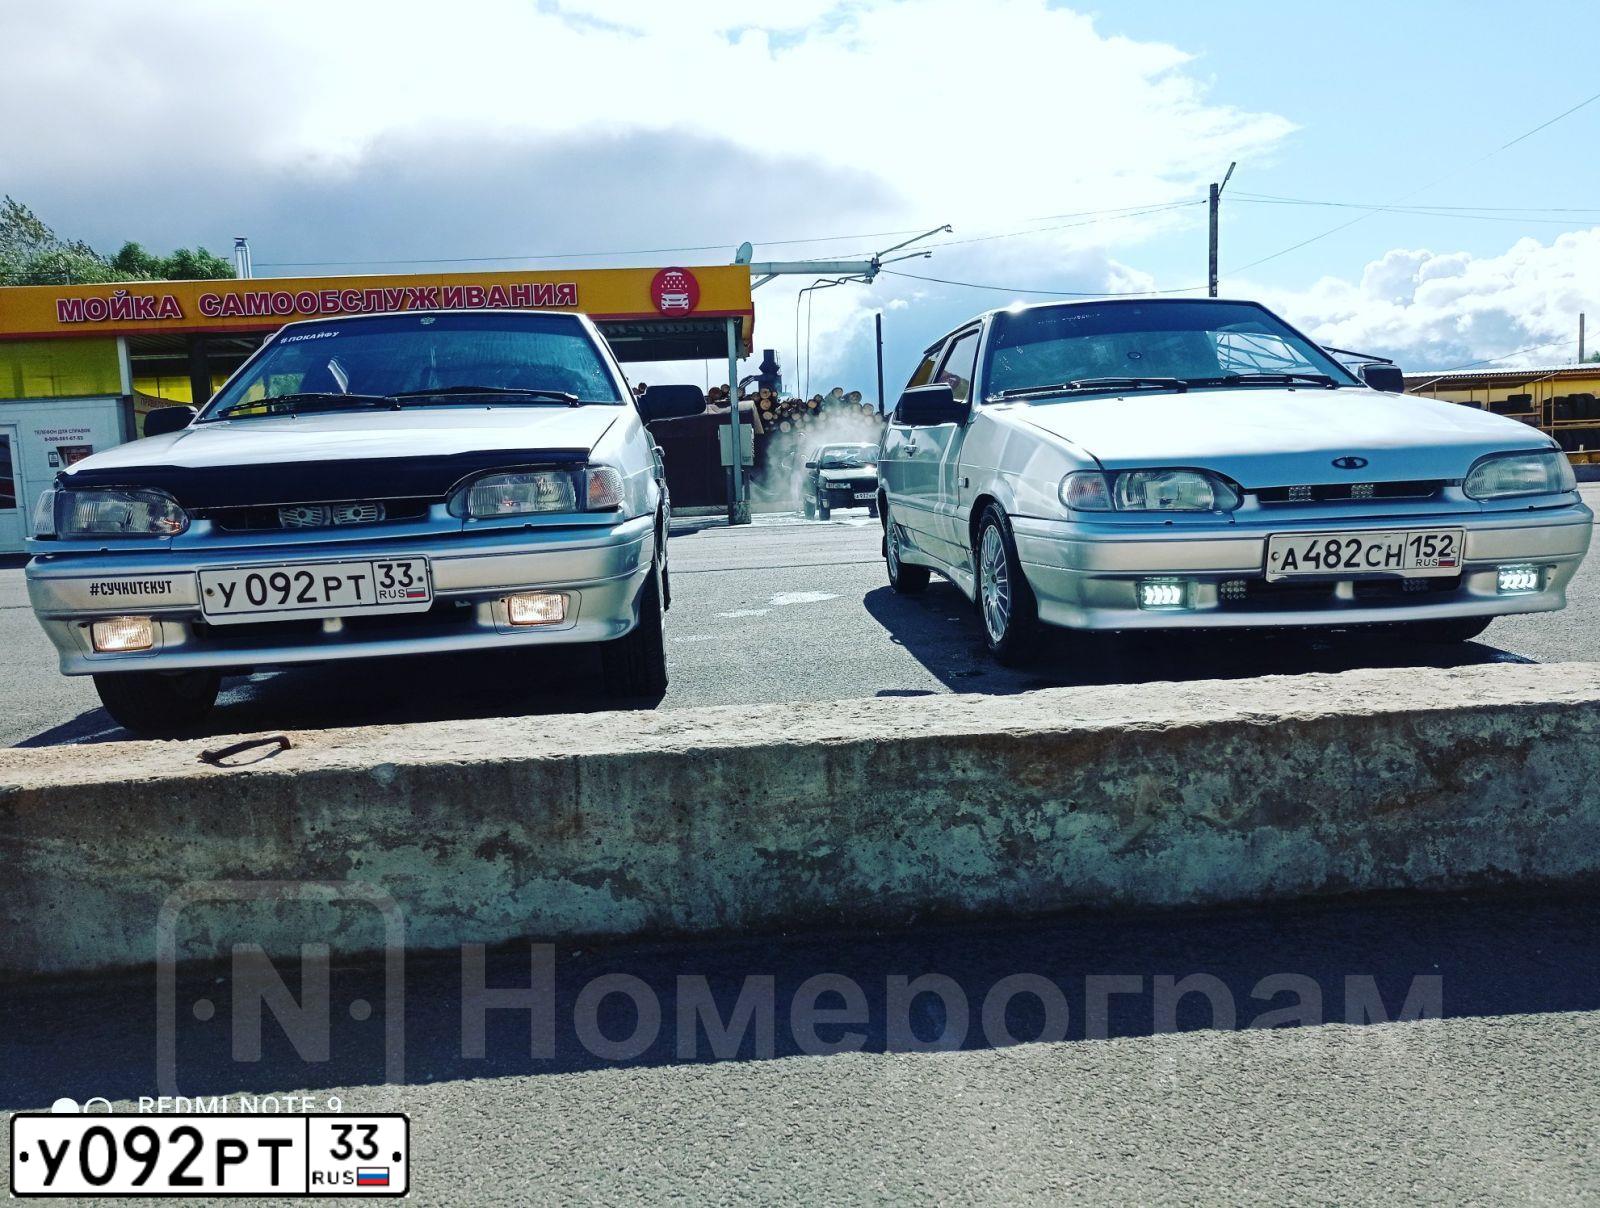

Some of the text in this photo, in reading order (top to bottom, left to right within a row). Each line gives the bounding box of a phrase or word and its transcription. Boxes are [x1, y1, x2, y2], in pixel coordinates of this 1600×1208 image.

[56, 282, 578, 323] МОЙКА САМООБСЛУЖИВАНИЯ
[1280, 534, 1454, 571] А482СН 152
[1416, 558, 1438, 567] RUS
[90, 580, 172, 596] #СУЧКИТЕКУТ
[217, 563, 414, 608] У092РТ 33
[379, 588, 406, 599] RUS
